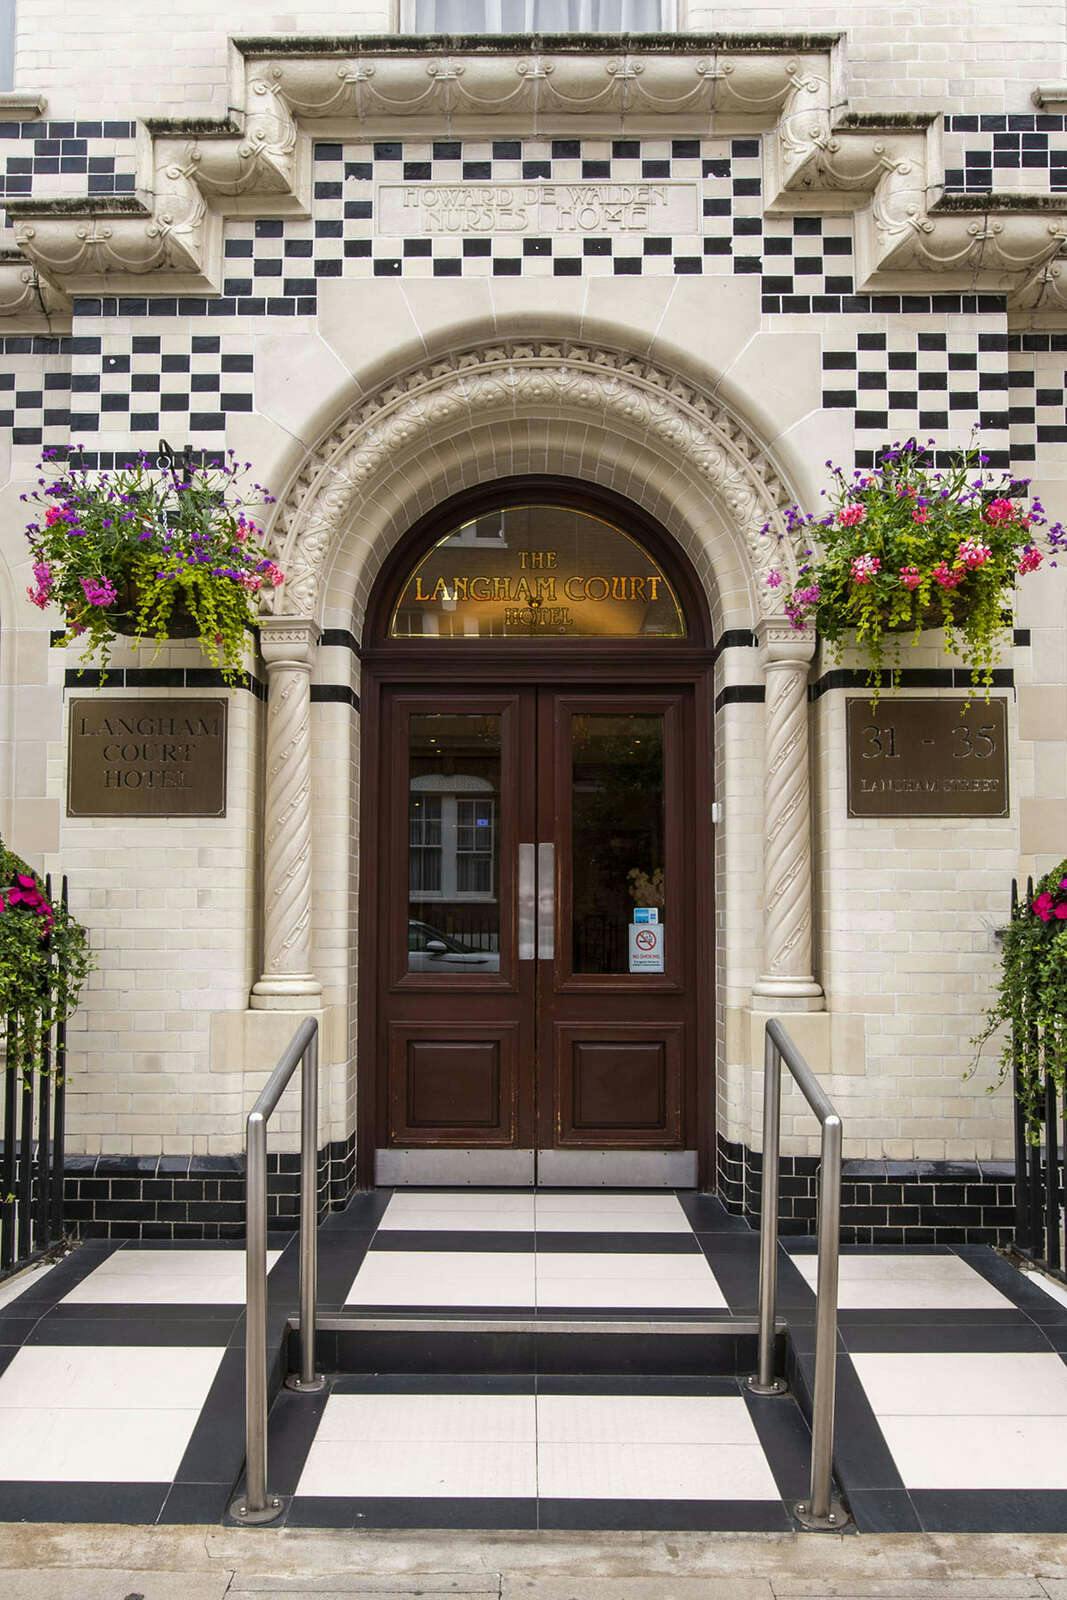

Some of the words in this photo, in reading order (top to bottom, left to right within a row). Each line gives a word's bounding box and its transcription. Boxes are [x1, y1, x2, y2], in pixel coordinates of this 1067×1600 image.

[403, 187, 513, 208] HOWARD
[525, 186, 556, 207] DE
[567, 185, 668, 206] WALDEN
[425, 208, 528, 232] NURSES
[556, 206, 648, 231] HOME
[518, 551, 558, 569] THE
[415, 576, 558, 601] LANGHAM
[564, 576, 662, 602] COURT
[504, 607, 574, 625] HOTEL
[79, 717, 221, 737] LANGHAM
[861, 724, 901, 759] 31
[951, 724, 997, 759] 35
[103, 743, 196, 763] COURT
[103, 769, 193, 789] HOTEL
[860, 779, 939, 793] LANGHAM
[943, 778, 1000, 793] STREET
